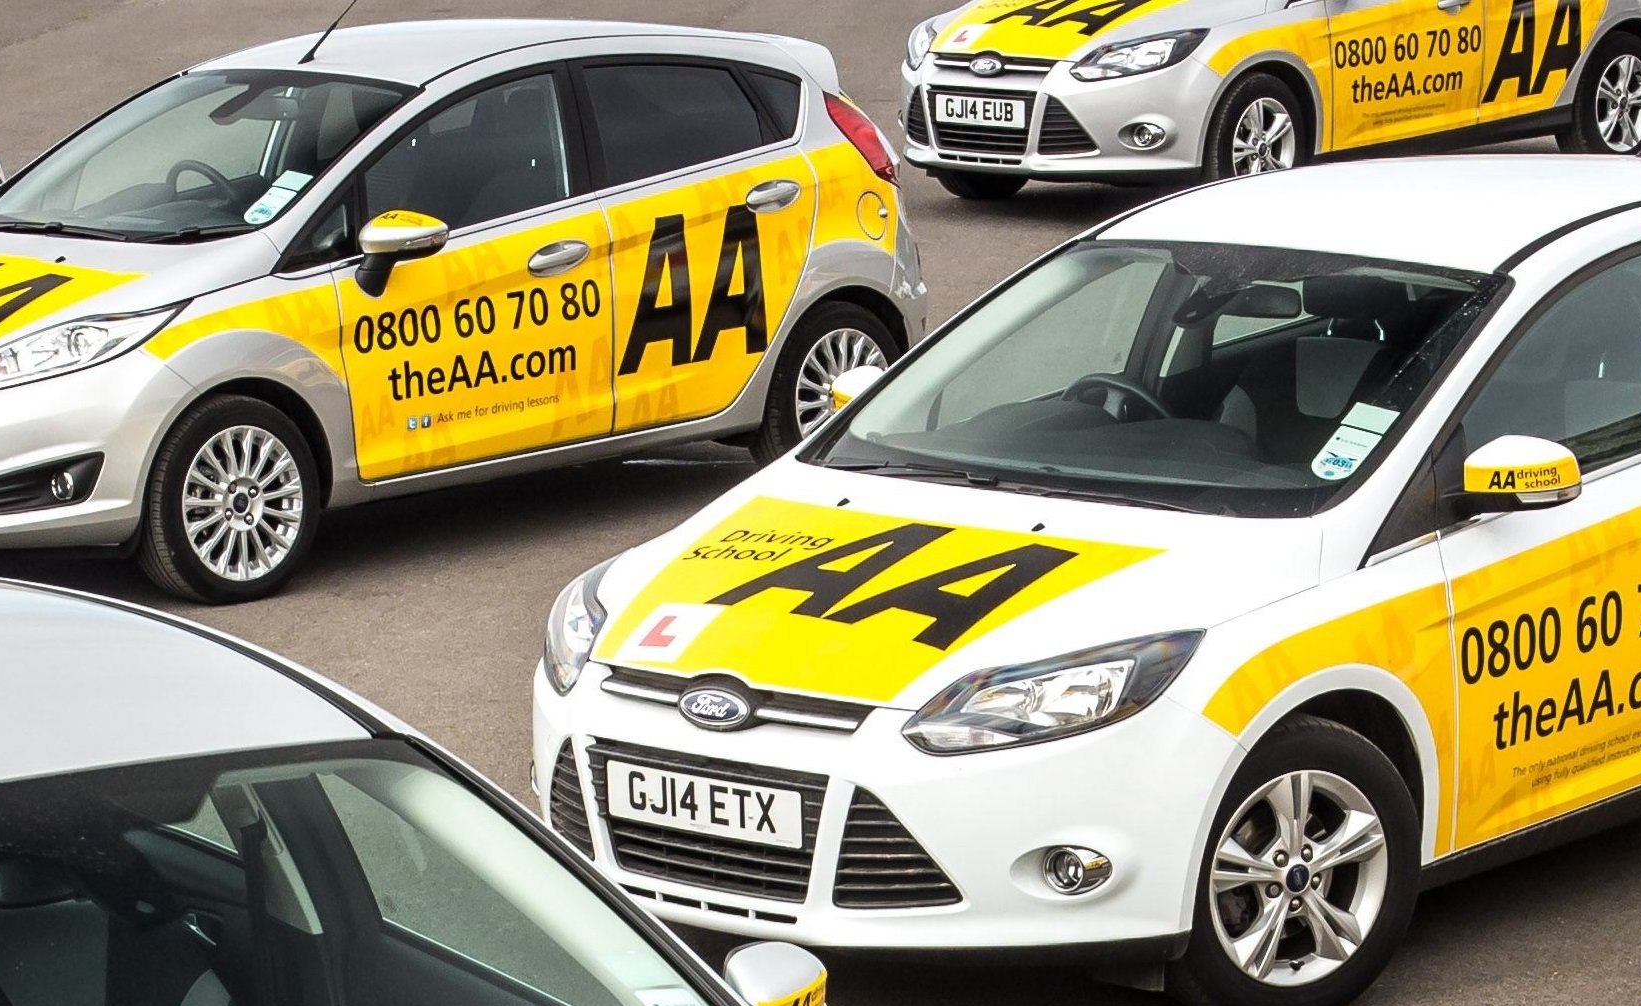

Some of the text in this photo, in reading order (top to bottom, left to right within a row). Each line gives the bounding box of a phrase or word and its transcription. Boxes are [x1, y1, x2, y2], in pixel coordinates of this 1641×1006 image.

[953, 30, 968, 43] L
[1334, 25, 1482, 69] 0800 60 70 80
[1481, 0, 1582, 104] AA
[1351, 69, 1464, 104] theAA.com
[945, 98, 1014, 122] GJ14 EUB
[617, 203, 768, 377] AA
[353, 279, 601, 354] 0800 60 70 80
[388, 344, 577, 401] theAA.com
[436, 394, 560, 424] Ask me for driving lessons
[1488, 467, 1558, 490] AA driving
[1524, 474, 1561, 489] school
[683, 544, 792, 562] School
[719, 528, 835, 550] Driving
[703, 522, 1079, 652] AA
[638, 616, 677, 647] L
[1461, 606, 1562, 685] 0800
[1576, 590, 1623, 654] 60
[691, 693, 730, 718] Ford
[628, 770, 777, 834] GJ14 ETX
